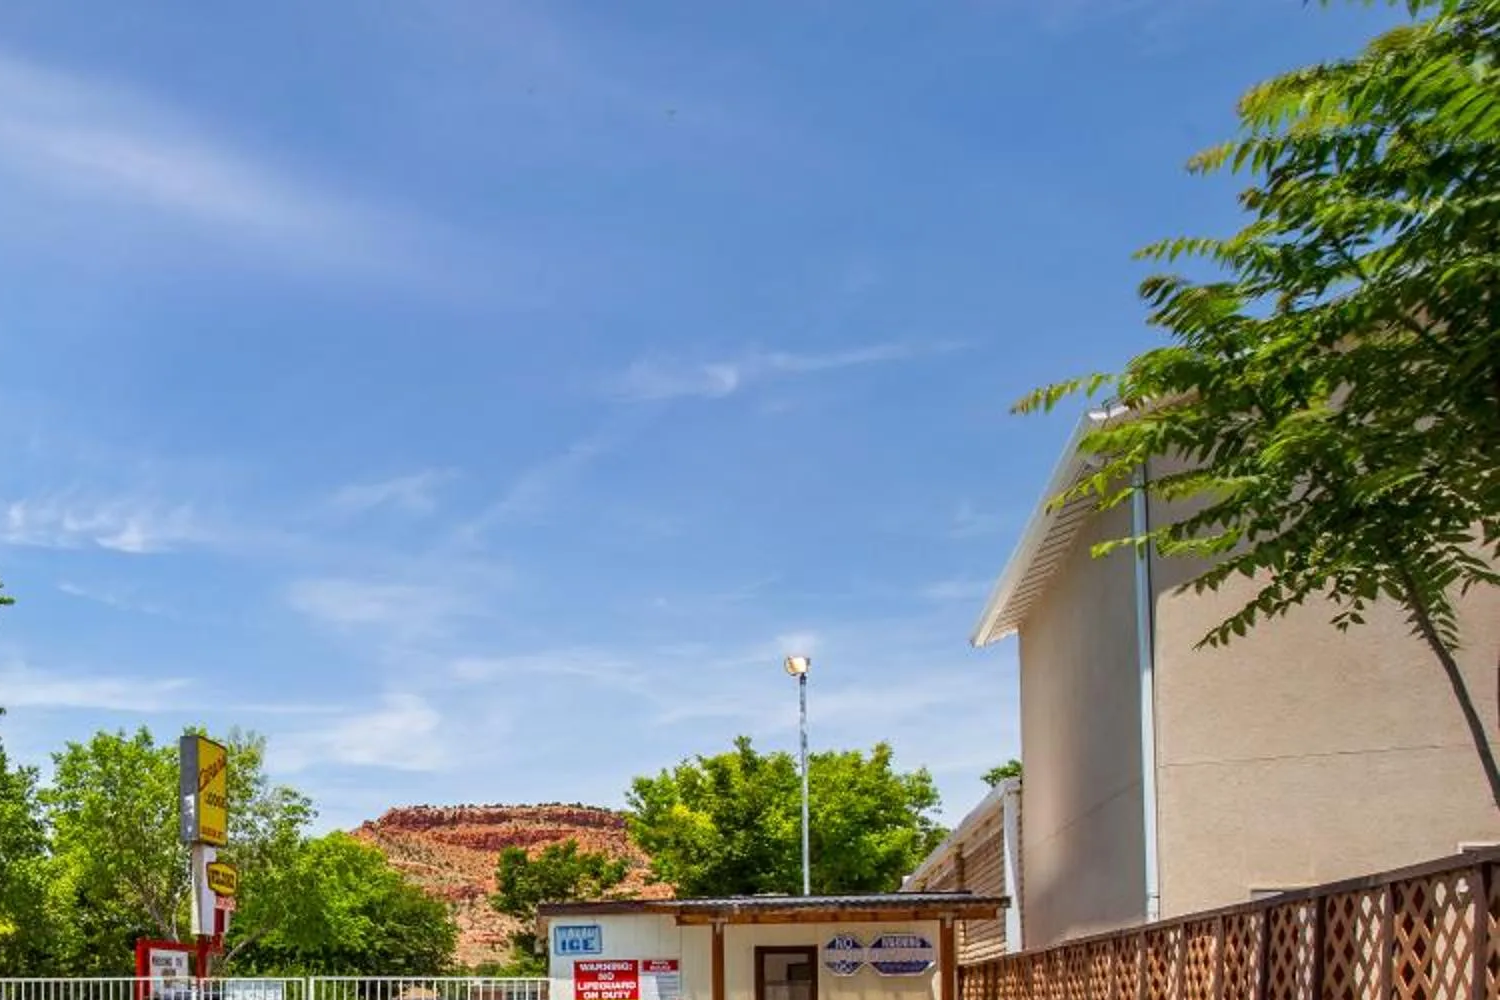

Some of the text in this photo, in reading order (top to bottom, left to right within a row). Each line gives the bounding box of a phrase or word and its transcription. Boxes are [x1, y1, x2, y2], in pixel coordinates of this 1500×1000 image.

[561, 939, 595, 951] ICE
[597, 972, 615, 980] NO
[577, 981, 637, 990] LIFEGUARD
[583, 991, 631, 999] ON DUTY
